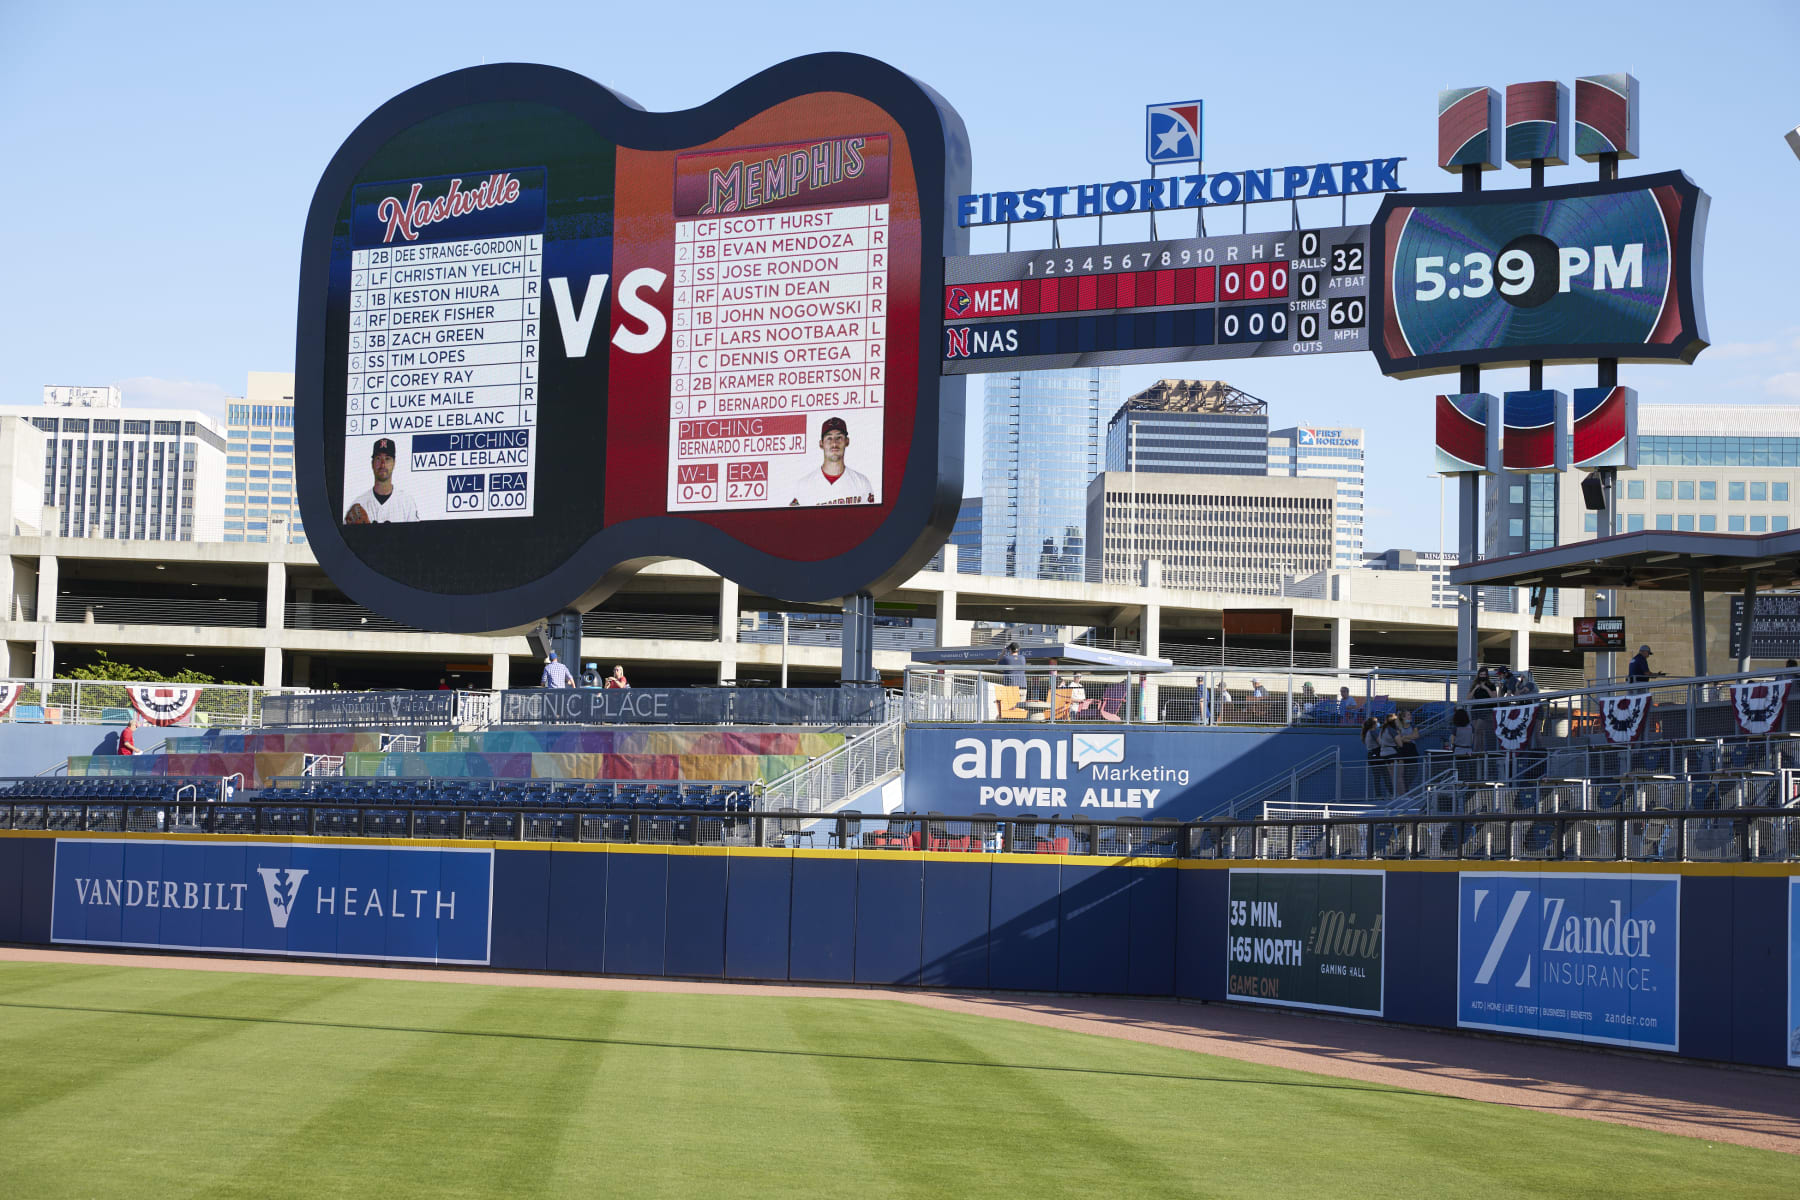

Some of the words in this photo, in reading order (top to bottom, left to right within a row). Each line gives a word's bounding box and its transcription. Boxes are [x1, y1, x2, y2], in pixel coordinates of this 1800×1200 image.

[698, 138, 865, 215] MEMPHIS
[958, 186, 1069, 228] FIRST
[1077, 168, 1273, 216] HORIZON
[1284, 157, 1400, 199] PARK
[378, 173, 520, 243] Nashville
[697, 223, 717, 236] CF
[724, 218, 775, 234] SCOTT
[781, 213, 833, 229] HURST
[875, 209, 883, 221] L
[372, 252, 389, 264] 2B
[395, 249, 415, 262] DEE
[419, 239, 522, 260] STRANGE-GORDON
[697, 246, 716, 259] 3B
[723, 241, 766, 257] EVAN
[772, 234, 853, 253] MENDOZA
[874, 231, 883, 244] R
[1302, 233, 1317, 255] 0
[697, 268, 715, 280] SS
[723, 264, 761, 279] JOSE
[768, 258, 838, 275] RONDON
[873, 254, 883, 267] R
[1046, 261, 1055, 274] 2
[1065, 259, 1074, 272] 3
[1083, 258, 1093, 271] 4
[1103, 256, 1112, 269] 5
[1122, 255, 1132, 268] 6
[1142, 253, 1151, 267] 7
[1161, 252, 1170, 265] 8
[1181, 250, 1190, 264] 9
[1197, 248, 1214, 262] 10
[1228, 247, 1238, 260] R
[1252, 245, 1263, 259] H
[1275, 243, 1284, 257] E
[1292, 258, 1327, 269] BALLS
[1333, 249, 1362, 272] 32
[372, 273, 387, 285] LF
[395, 266, 466, 283] CHRISTIAN
[472, 261, 520, 277] YELICH
[1329, 278, 1342, 288] AT
[1345, 276, 1365, 287] BAT
[1415, 249, 1535, 301] 5:39
[1558, 243, 1644, 293] PM
[372, 294, 385, 305] 1B
[394, 288, 450, 304] KESTON
[456, 285, 499, 299] HIURA
[696, 290, 715, 302] RF
[722, 285, 779, 301] AUSTIN
[785, 281, 830, 296] DEAN
[873, 277, 882, 289] R
[975, 288, 1018, 312] MEM
[1225, 272, 1239, 293] 0
[1250, 271, 1264, 291] 0
[1272, 269, 1286, 290] 0
[1302, 275, 1316, 296] 0
[370, 314, 386, 326] RF
[393, 310, 439, 325] DEREK
[445, 306, 494, 321] FISHER
[548, 267, 667, 358] VS
[697, 312, 712, 325] 1B
[721, 308, 763, 323] JOHN
[770, 301, 860, 319] NOGOWSKI
[872, 300, 881, 312] R
[1290, 300, 1327, 311] STRIKES
[1331, 301, 1363, 324] 60
[695, 333, 712, 346] LF
[721, 330, 761, 345] LARS
[767, 323, 859, 342] NOOTBAAR
[872, 322, 880, 334] L
[974, 329, 1018, 353] NAS
[1224, 315, 1238, 336] 0
[1250, 313, 1263, 334] 0
[1272, 312, 1286, 333] 0
[1301, 316, 1316, 337] 0
[1335, 330, 1359, 340] MPH
[369, 335, 385, 347] 3B
[392, 331, 430, 346] ZACH
[435, 328, 484, 342] GREEN
[1293, 342, 1323, 352] OUTS
[369, 356, 384, 367] SS
[392, 354, 414, 366] TIM
[420, 350, 465, 364] LOPES
[699, 355, 708, 368] C
[720, 351, 778, 367] DENNIS
[784, 346, 850, 364] ORTEGA
[871, 345, 880, 357] R
[367, 376, 384, 388] CF
[391, 373, 439, 387] COREY
[444, 370, 473, 384] RAY
[693, 378, 711, 390] 2B
[719, 374, 774, 389] KRAMER
[779, 368, 861, 387] ROBERTSON
[871, 367, 880, 380] R
[371, 398, 379, 409] C
[390, 394, 425, 408] LUKE
[431, 392, 474, 405] MAILE
[699, 401, 706, 413] P
[719, 396, 787, 412] BERNARDO
[791, 393, 839, 408] FLORES
[843, 392, 860, 406] JR.
[871, 391, 879, 403] L
[371, 419, 379, 430] P
[389, 415, 433, 429] WADE
[438, 412, 504, 426] LEBLANC
[680, 419, 763, 437] PITCHING
[450, 431, 527, 449] PITCHING
[680, 439, 740, 455] BERNARDO
[744, 437, 785, 453] FLORES
[789, 436, 805, 450] JR.
[1316, 438, 1358, 446] HORIZON
[414, 453, 456, 467] WADE
[462, 450, 527, 465] LEBLANC
[491, 474, 525, 489] ERA
[680, 467, 715, 481] W-L
[729, 464, 765, 479] ERA
[450, 476, 482, 491] W-L
[683, 486, 711, 499] 0-0
[730, 483, 764, 498] 2.70
[452, 495, 478, 508] 0-0
[490, 493, 524, 506] 0.00
[332, 702, 385, 713] VANDERBILT
[406, 701, 444, 712] HEALTH
[509, 695, 581, 717] PICNIC
[590, 693, 669, 717] PLACE
[952, 738, 1067, 780] ami
[1092, 765, 1189, 785] Marketing
[980, 786, 1067, 807] POWER
[1081, 788, 1160, 809] ALLEY
[75, 878, 247, 911] VANDERBILT
[317, 887, 456, 919] HEALTH
[1231, 901, 1246, 925] 35
[1251, 902, 1281, 928] MIN.
[1315, 910, 1382, 959] Mint
[1543, 898, 1655, 957] Zander
[1230, 936, 1250, 962] I-65
[1254, 938, 1302, 966] NORTH
[1321, 964, 1346, 975] GAMING
[1230, 975, 1258, 995] GAME
[1261, 977, 1279, 998] ON!
[1487, 1002, 1501, 1011] HOME
[1505, 1004, 1514, 1012] LIFE
[1519, 1005, 1523, 1013] ID
[1524, 1006, 1537, 1015] THEFT
[1543, 1008, 1565, 1018] BUSINESS
[1571, 1011, 1592, 1021] BENEFITS
[1605, 1013, 1657, 1027] zander.com
